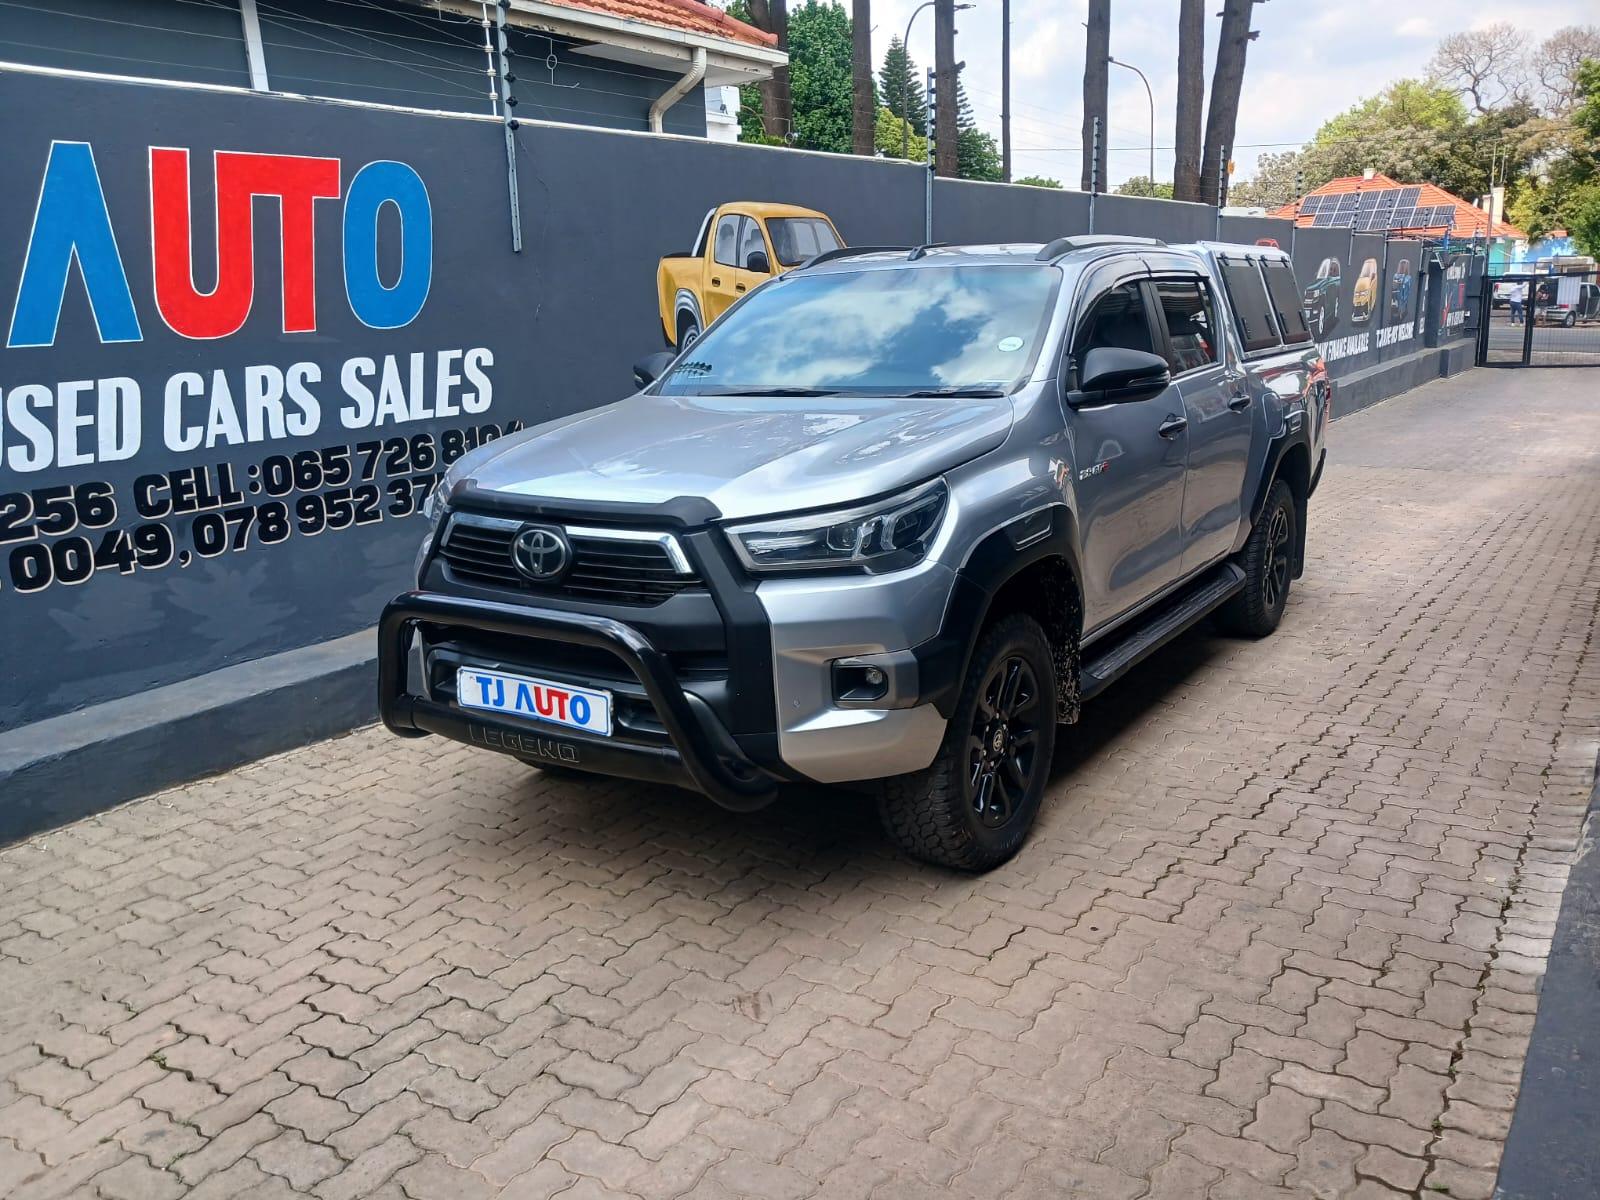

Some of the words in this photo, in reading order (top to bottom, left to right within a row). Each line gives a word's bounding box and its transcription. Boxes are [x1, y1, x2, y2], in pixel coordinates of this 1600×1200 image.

[7, 140, 433, 348] AUTO
[0, 376, 142, 473] SED
[163, 361, 322, 453] CARS
[340, 347, 494, 430] SALES
[358, 433, 437, 481] 726
[295, 485, 383, 537] 952
[388, 472, 445, 517] 37
[475, 675, 505, 707] TJ
[515, 683, 591, 725] AUTO
[468, 722, 580, 763] LEGEND
